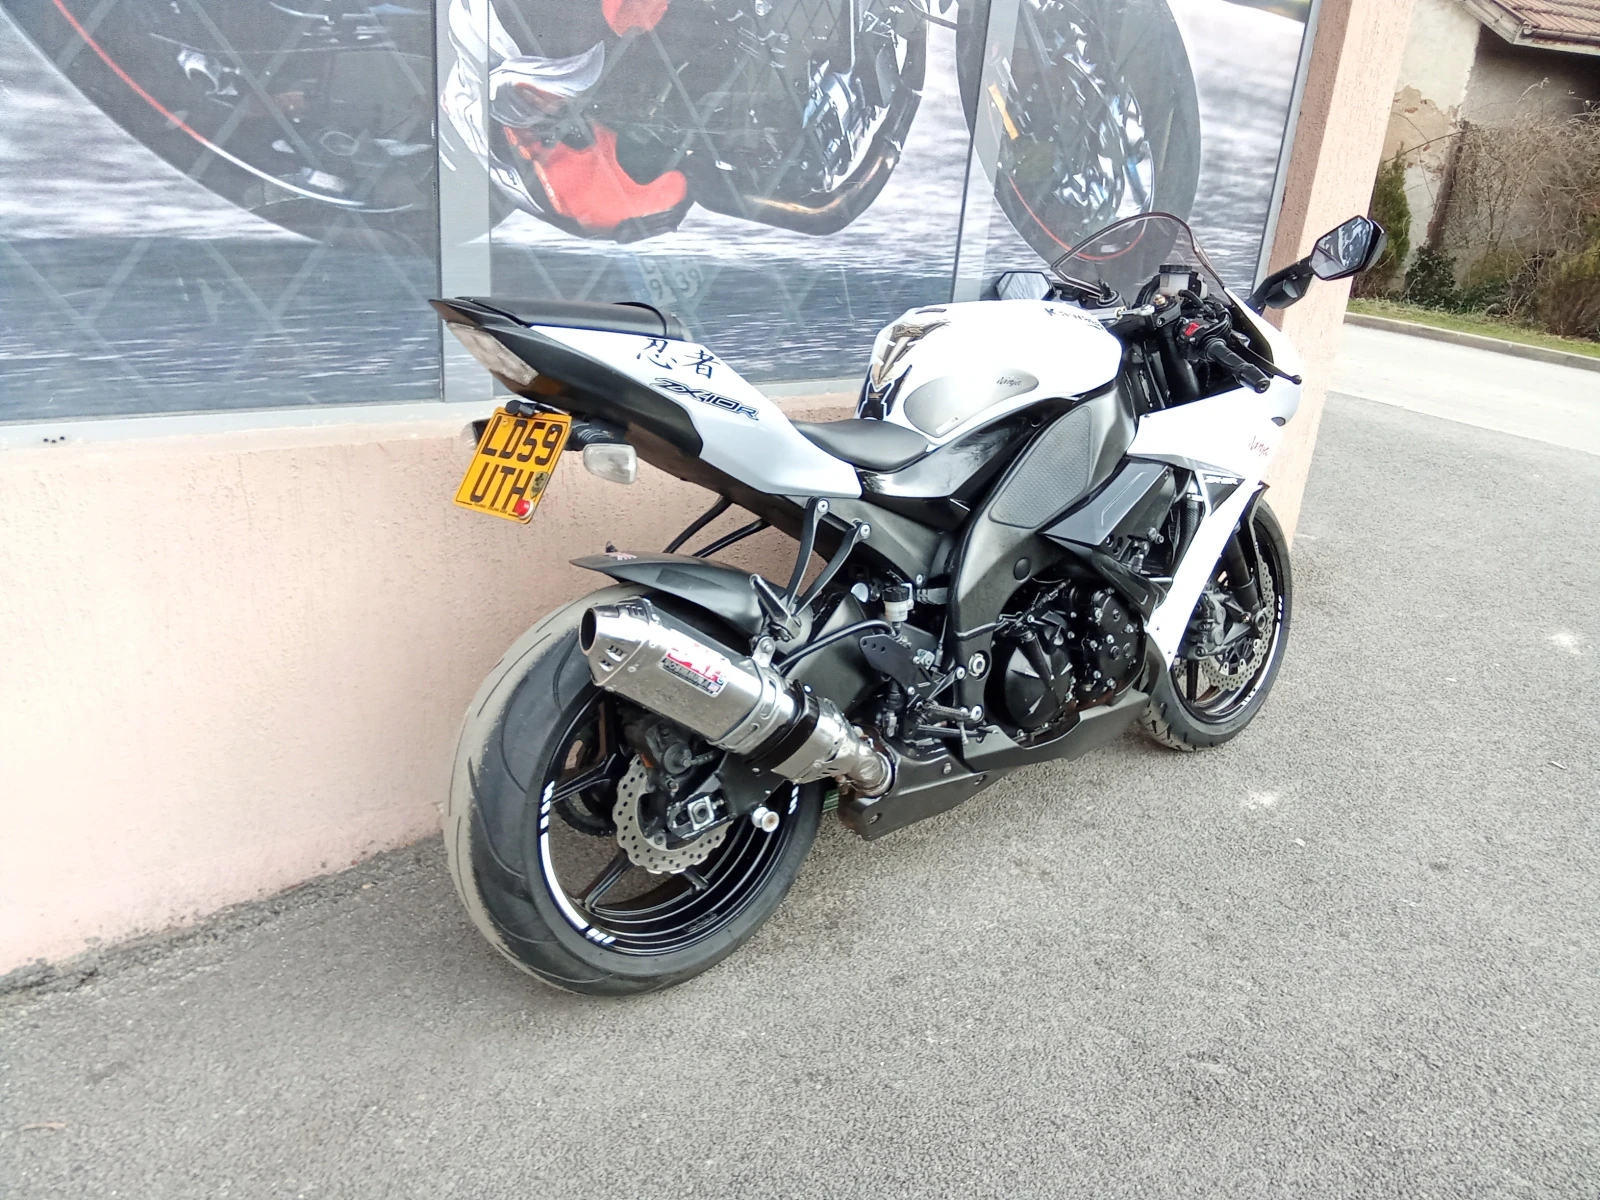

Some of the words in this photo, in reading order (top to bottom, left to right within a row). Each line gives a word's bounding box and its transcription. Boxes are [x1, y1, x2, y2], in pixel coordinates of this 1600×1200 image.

[637, 338, 720, 379] 忍者
[997, 376, 1022, 387] Ninja
[481, 416, 563, 466] LD59
[470, 462, 534, 513] UTH
